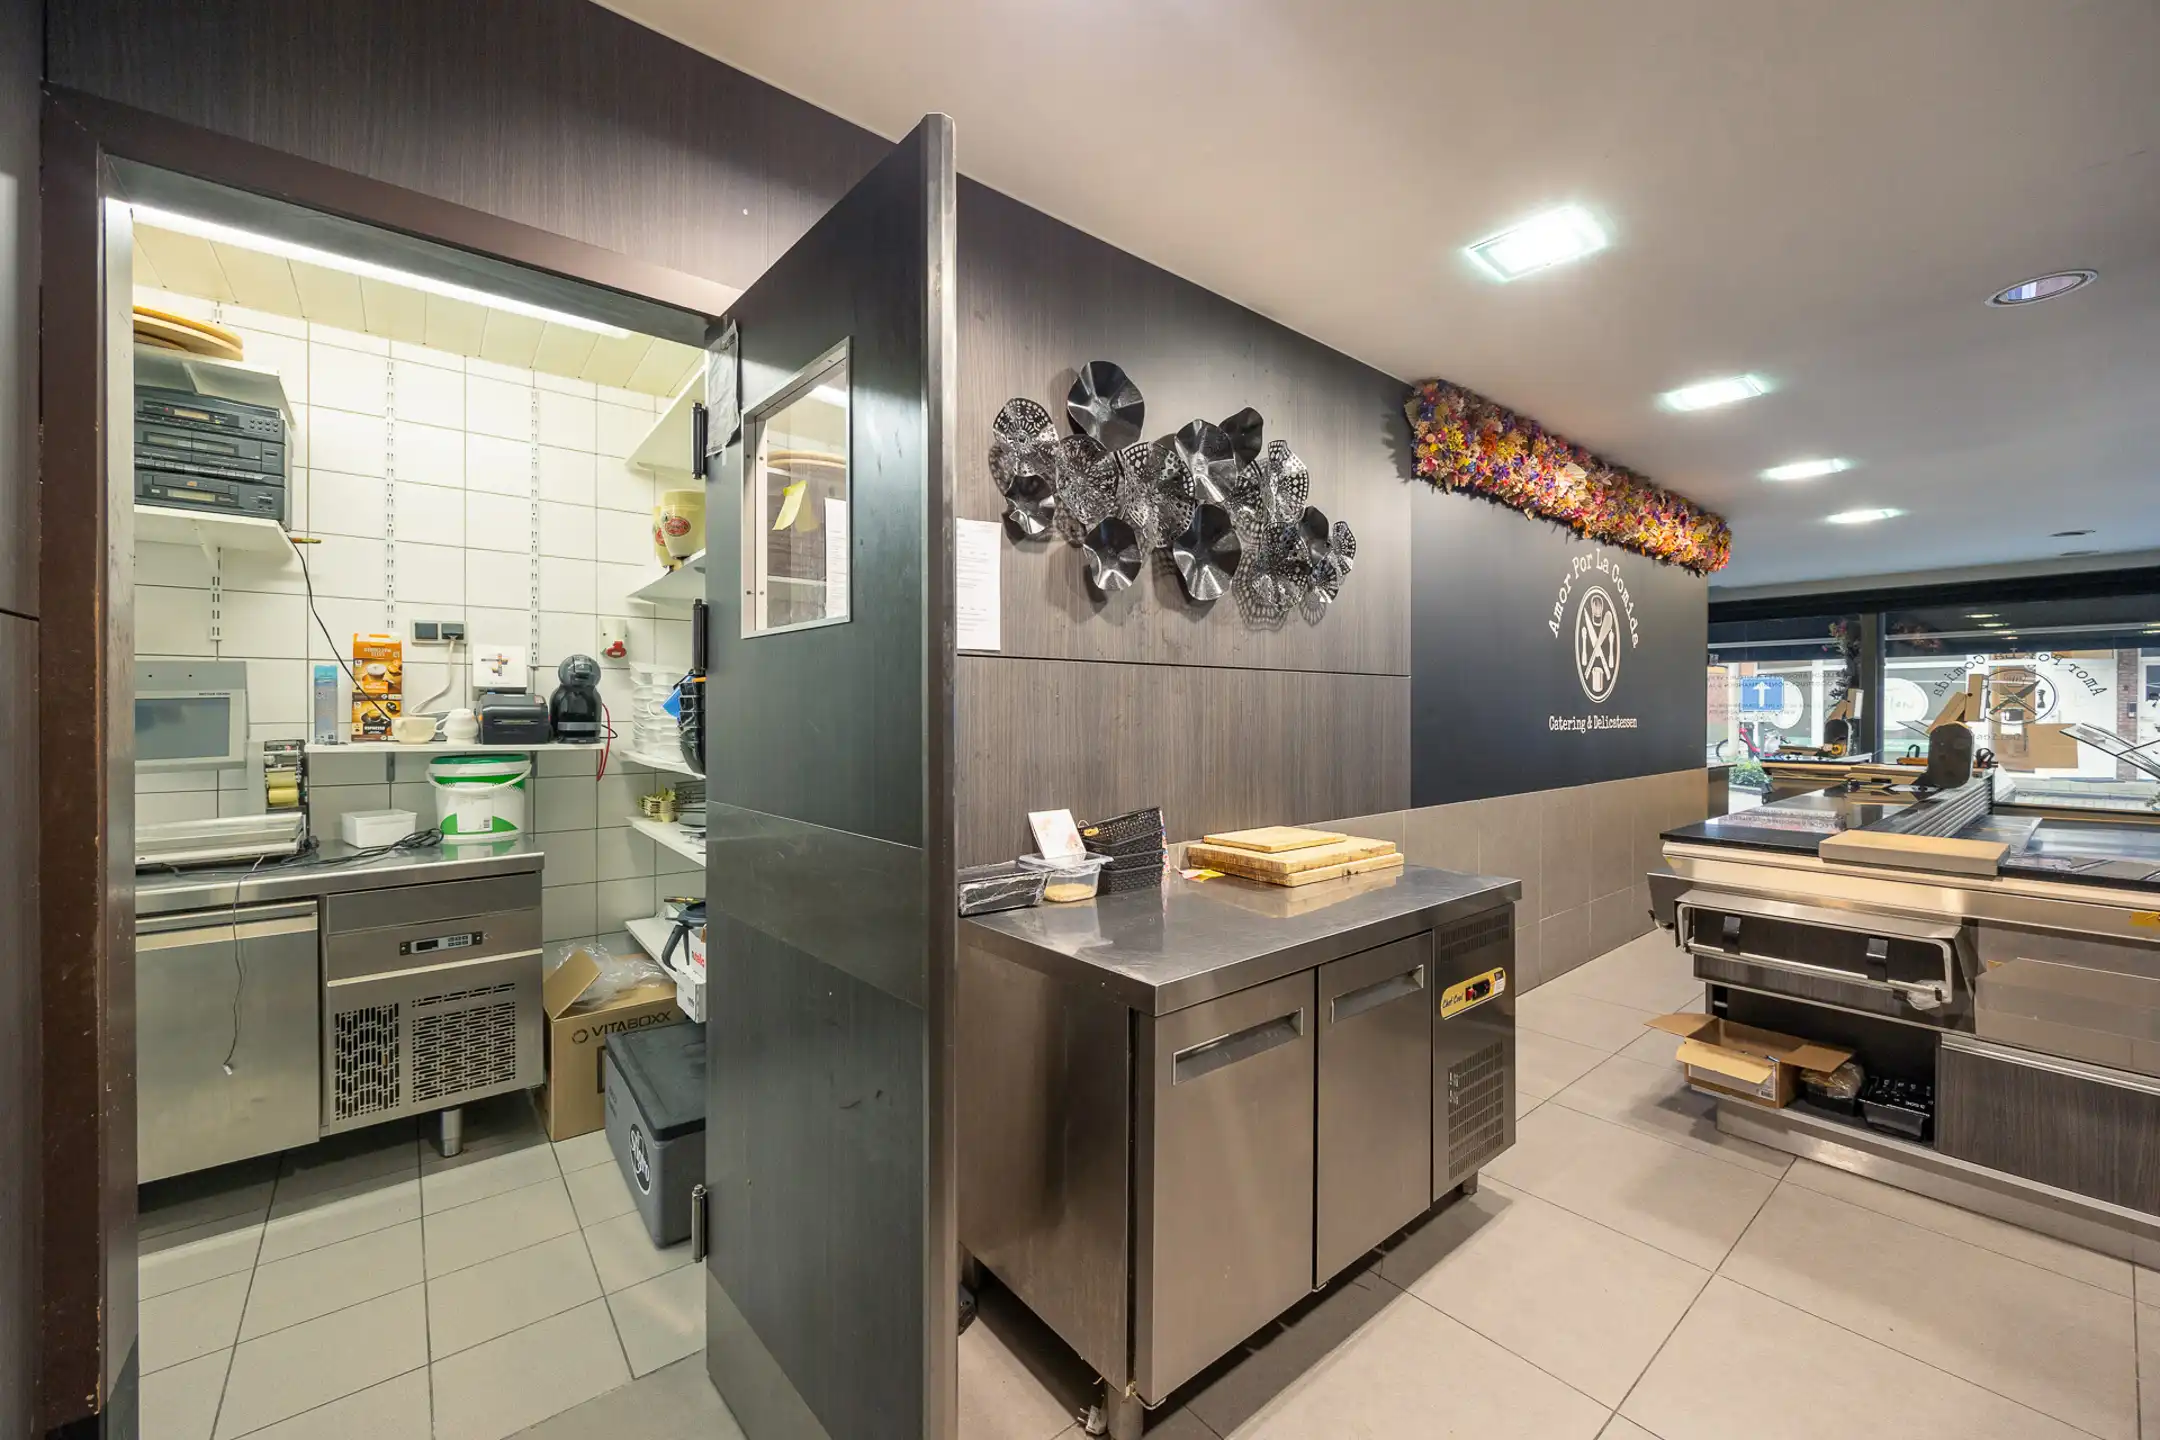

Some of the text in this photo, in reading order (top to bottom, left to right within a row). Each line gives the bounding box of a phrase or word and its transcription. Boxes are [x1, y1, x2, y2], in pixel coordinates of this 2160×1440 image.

[1548, 547, 1639, 648] Amor Por La Comida
[1548, 714, 1638, 734] Catering & Delicatessen
[591, 1011, 672, 1037] VITABOXX
